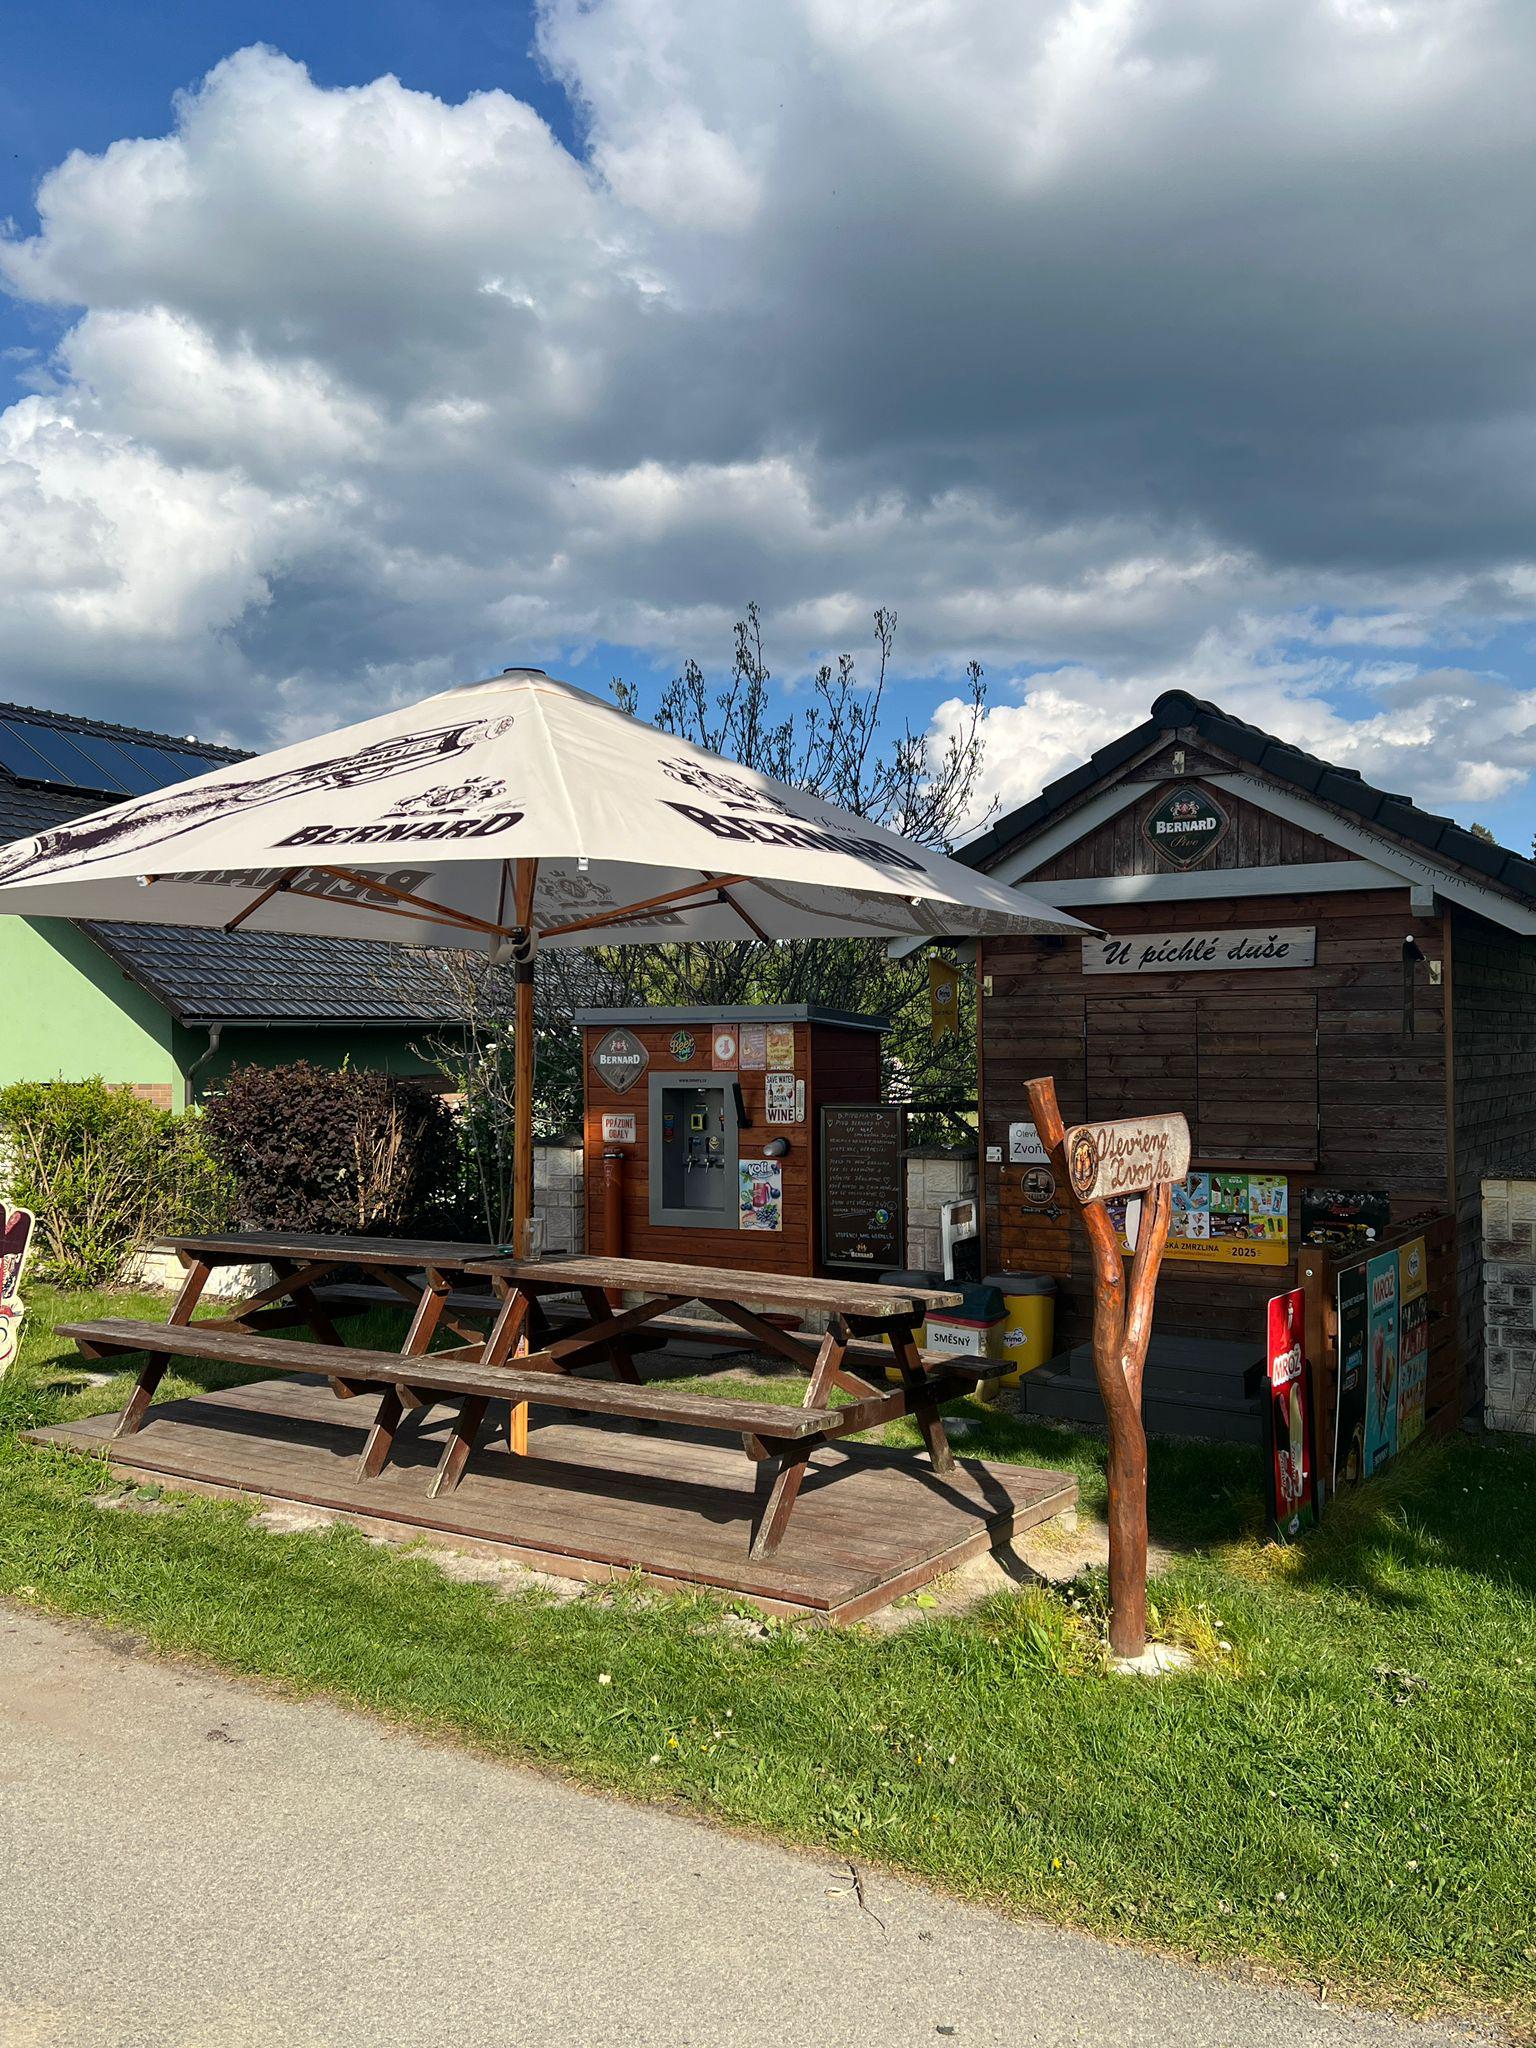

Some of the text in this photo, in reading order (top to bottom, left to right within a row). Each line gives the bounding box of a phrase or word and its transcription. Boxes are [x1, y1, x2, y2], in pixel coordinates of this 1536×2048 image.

[268, 812, 524, 849] BERNARD
[1156, 818, 1217, 834] BERNARD
[657, 799, 928, 873] BERNARD
[1170, 834, 1199, 848] Pivo
[1103, 935, 1289, 970] U píchlé duše
[670, 1037, 695, 1055] Beer
[600, 1054, 640, 1065] BERNARD
[766, 1075, 794, 1084] SAVE WATER
[767, 1109, 794, 1121] WINE
[606, 1118, 633, 1129] PRÁZDNÉ
[609, 1129, 629, 1139] OBALY
[1016, 1129, 1039, 1138] Otevř
[1014, 1142, 1046, 1154] Zvoň
[1181, 1243, 1219, 1252] ZMRZLINA
[1231, 1247, 1257, 1257] 2025
[934, 1333, 971, 1347] SMĚSNÝ
[1273, 1344, 1301, 1384] MROŽ
